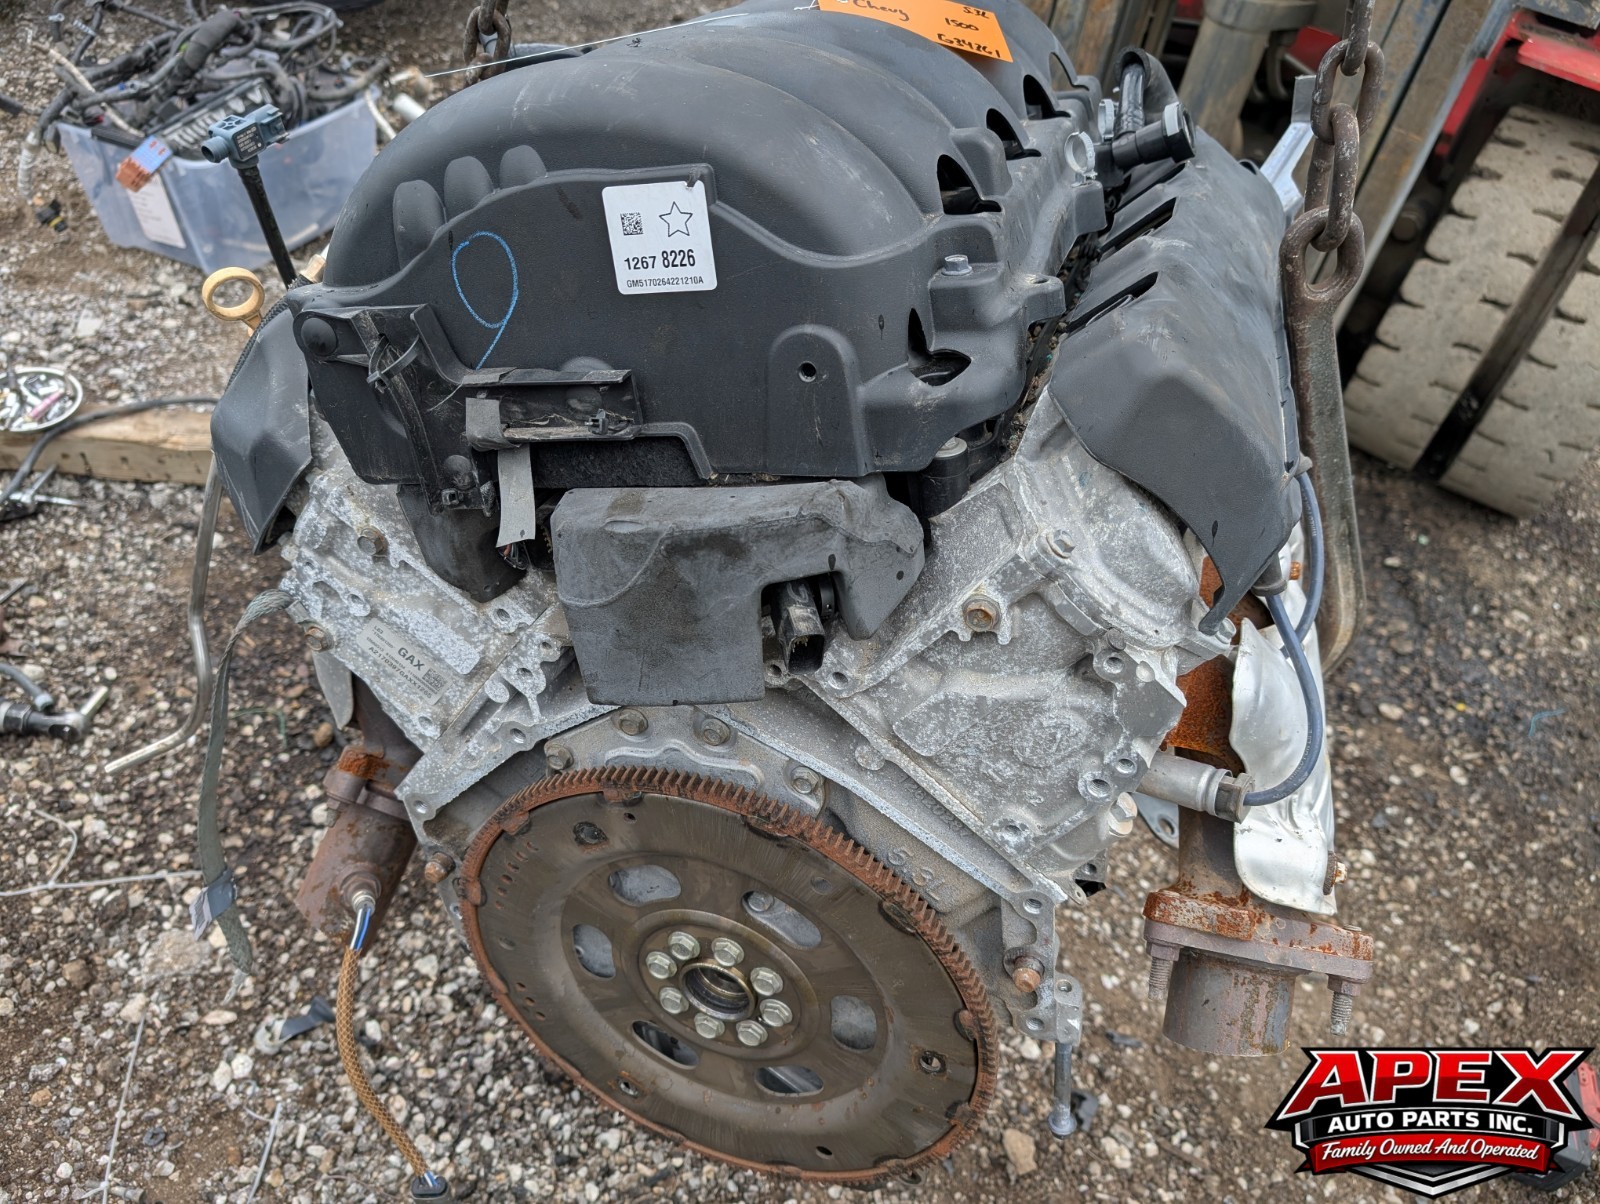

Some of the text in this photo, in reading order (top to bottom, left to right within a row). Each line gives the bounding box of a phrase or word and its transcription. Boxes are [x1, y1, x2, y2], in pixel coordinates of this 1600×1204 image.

[944, 17, 980, 31] 1500
[624, 248, 696, 270] 1267 8226
[626, 276, 704, 288] GM5170264221210A
[397, 647, 425, 671] GAX
